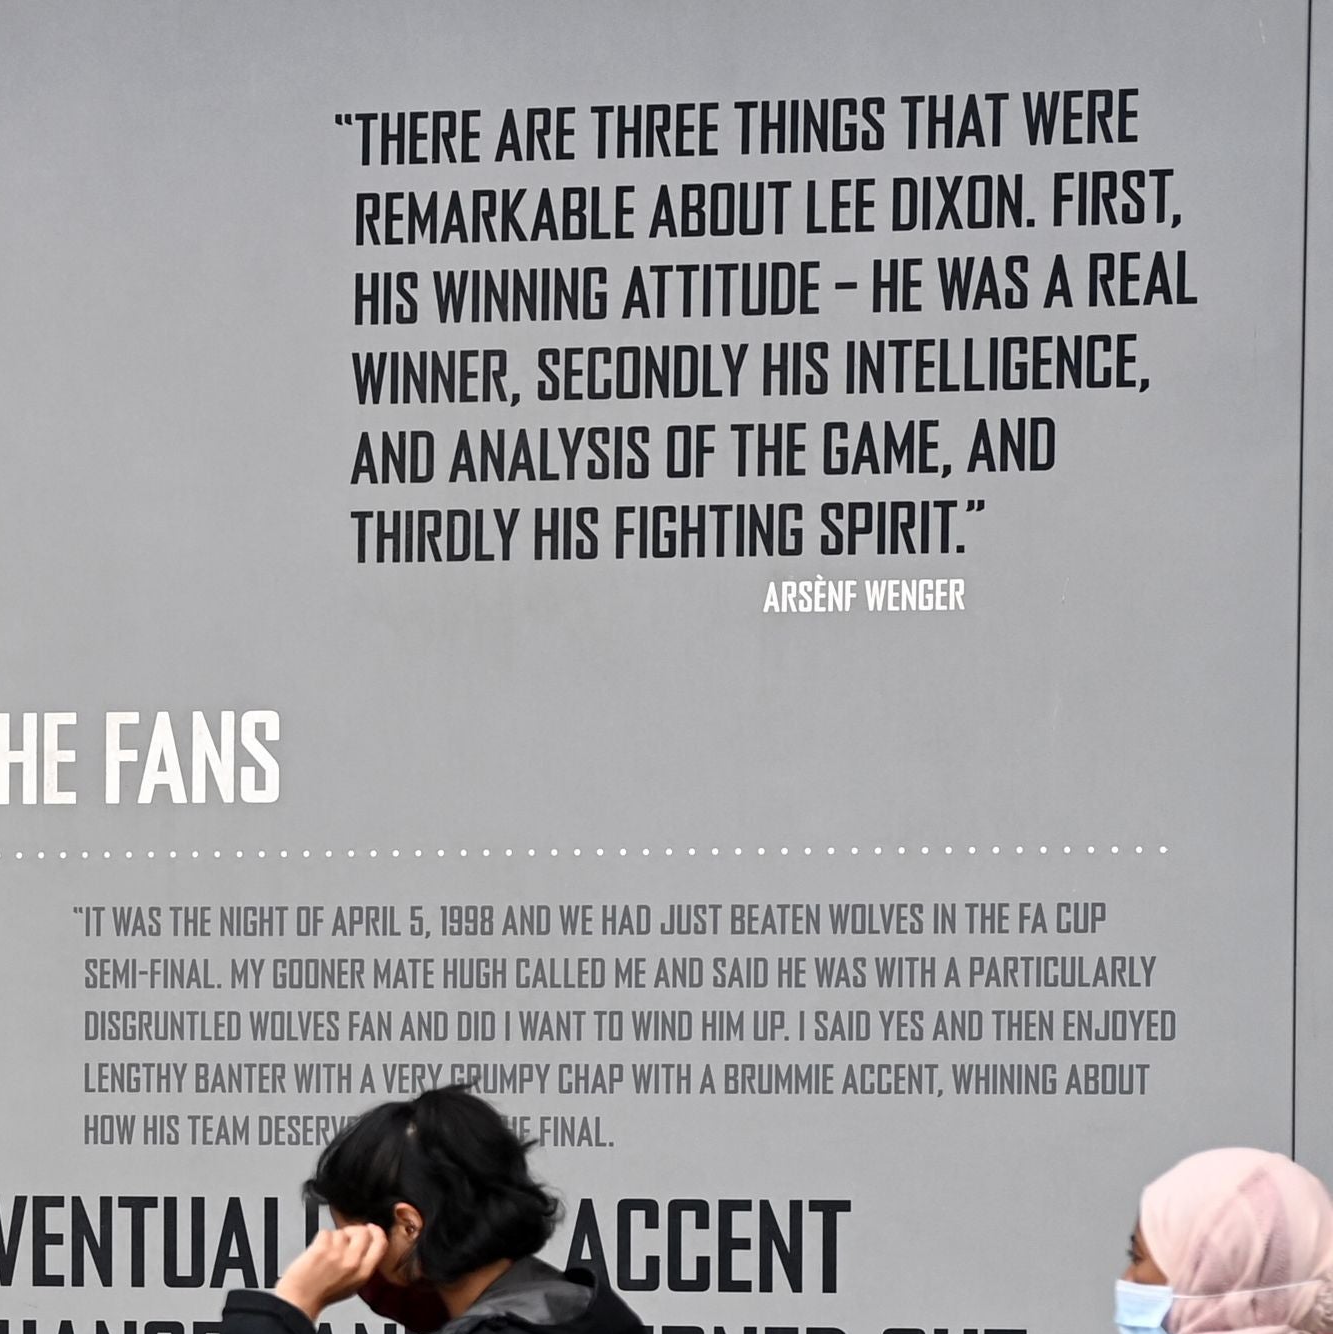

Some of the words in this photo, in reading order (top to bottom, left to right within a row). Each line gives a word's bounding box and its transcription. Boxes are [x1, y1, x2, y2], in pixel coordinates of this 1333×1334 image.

[335, 110, 480, 166] “THERE
[495, 107, 575, 162] ARE
[591, 102, 719, 159] THREE
[734, 97, 884, 154] THINGS
[901, 93, 1009, 149] THAT
[1023, 88, 1138, 145] WERE
[356, 186, 635, 245] REMARKABLE
[649, 181, 791, 238] ABOUT
[807, 179, 875, 233] LEE
[892, 174, 1035, 231] DIXON.
[1054, 169, 1181, 228] FIRST,
[355, 272, 418, 325] HIS
[433, 267, 607, 323] WINNING
[622, 261, 820, 319] ATTITUDE
[873, 258, 922, 312] HE
[938, 255, 1028, 311] WAS
[1044, 254, 1073, 308] A
[1089, 251, 1197, 307] REAL
[352, 350, 520, 407] WINNER,
[538, 344, 748, 400] SECONDLY
[763, 342, 828, 396] HIS
[846, 334, 1149, 394] INTELLIGENCE,
[351, 431, 434, 484] AND
[449, 426, 649, 482] ANALYSIS
[667, 425, 715, 478] OF
[731, 423, 806, 477] THE
[824, 420, 951, 478] GAME,
[967, 417, 1055, 472] AND
[351, 509, 520, 563] THIRDLY
[535, 507, 598, 560] HIS
[616, 503, 802, 559] FIGHTING
[821, 500, 984, 555] SPIRIT.”
[865, 579, 964, 611] WENGER
[106, 711, 279, 803] FANS
[112, 907, 161, 936] WAS
[170, 907, 211, 936] THE
[220, 906, 288, 936] NIGHT
[297, 906, 324, 936] OF
[332, 906, 401, 936] APRIL
[411, 906, 430, 939] 5,
[441, 906, 493, 936] 1998
[502, 905, 550, 935] AND
[559, 905, 592, 935] WE
[602, 905, 650, 935] HAD
[661, 904, 722, 935] JUST
[731, 904, 820, 934] BEATEN
[829, 904, 923, 934] WOLVES
[934, 903, 956, 934] IN
[965, 903, 1009, 934] THE
[1019, 903, 1047, 933] FA
[1057, 903, 1106, 933] CUP
[85, 959, 221, 988] SEMI-FINAL.
[231, 959, 265, 988] MY
[273, 959, 364, 988] GOONER
[374, 959, 434, 988] MATE
[444, 958, 506, 988] HUGH
[516, 958, 605, 988] CALLED
[615, 958, 646, 988] ME
[654, 958, 703, 988] AND
[713, 958, 768, 988] SAID
[778, 958, 806, 988] HE
[815, 957, 866, 988] WAS
[875, 957, 935, 987] WITH
[944, 957, 960, 987] A
[970, 956, 1156, 987] PARTICULARLY
[85, 1011, 240, 1040] DISGRUNTLED
[250, 1011, 339, 1041] WOLVES
[349, 1011, 391, 1041] FAN
[400, 1011, 448, 1041] AND
[458, 1011, 495, 1041] DID
[505, 1011, 510, 1041] I
[519, 1011, 586, 1041] WANT
[594, 1011, 623, 1041] TO
[632, 1011, 692, 1041] WIND
[702, 1011, 744, 1041] HIM
[754, 1011, 789, 1041] UP.
[800, 1011, 804, 1041] I
[815, 1011, 870, 1041] SAID
[879, 1011, 923, 1041] YES
[933, 1010, 982, 1041] AND
[992, 1010, 1053, 1041] THEN
[1064, 1010, 1175, 1041] ENJOYED
[85, 1063, 187, 1092] LENGTHY
[196, 1063, 285, 1093] BANTER
[294, 1064, 351, 1093] WITH
[360, 1064, 375, 1093] A
[383, 1064, 442, 1093] VERY
[450, 1064, 550, 1093] GRUMPY
[558, 1064, 623, 1094] CHAP
[632, 1064, 691, 1094] WITH
[700, 1064, 715, 1094] A
[725, 1064, 833, 1094] BRUMMIE
[842, 1064, 943, 1097] ACCENT,
[952, 1064, 1056, 1094] WHINING
[1065, 1064, 1150, 1095] ABOUT
[85, 1115, 135, 1144] HOW
[144, 1115, 179, 1145] HIS
[188, 1115, 249, 1145] TEAM
[539, 1117, 614, 1147] FINAL.
[565, 1199, 851, 1293] ACCENT
